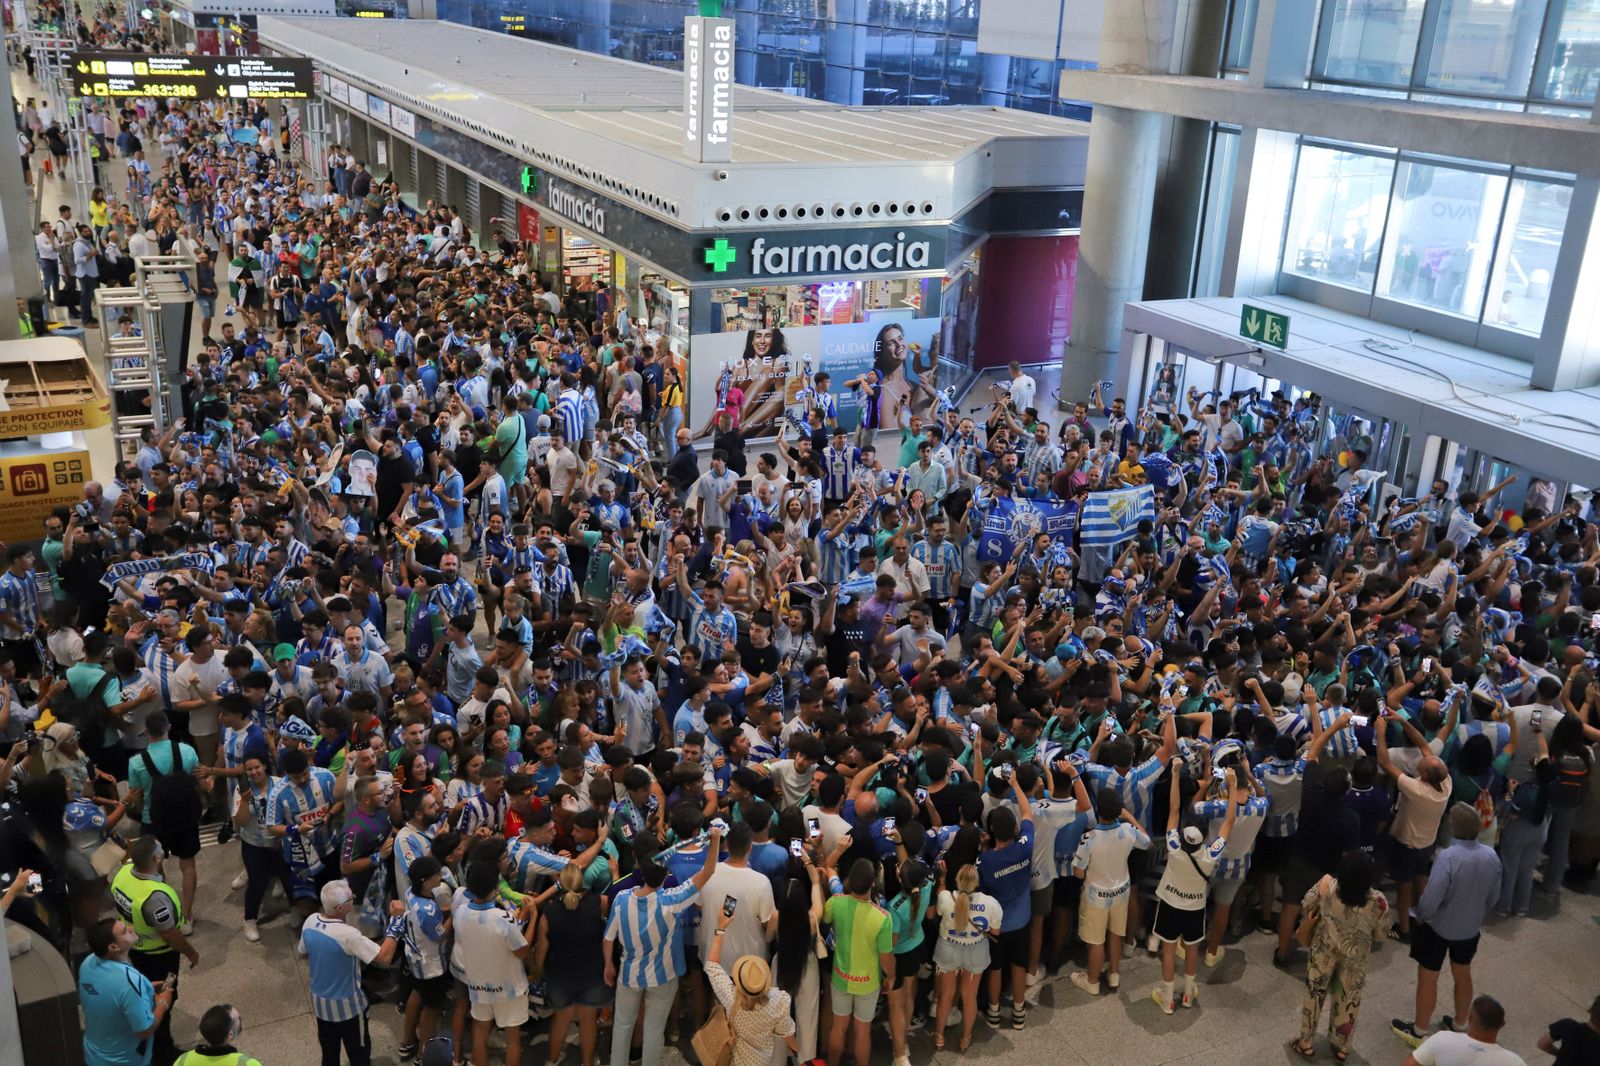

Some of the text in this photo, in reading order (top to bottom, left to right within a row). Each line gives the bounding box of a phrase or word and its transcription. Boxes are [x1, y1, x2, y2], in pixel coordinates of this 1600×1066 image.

[143, 84, 168, 97] 363
[172, 84, 197, 97] 386
[686, 23, 699, 142] farmacia
[708, 25, 731, 144] farmacia
[548, 177, 605, 235] farmacia
[751, 231, 930, 275] farmacia
[11, 408, 84, 422] PROTECTION
[32, 418, 86, 432] EQUIPAJES
[987, 538, 1003, 558] 8
